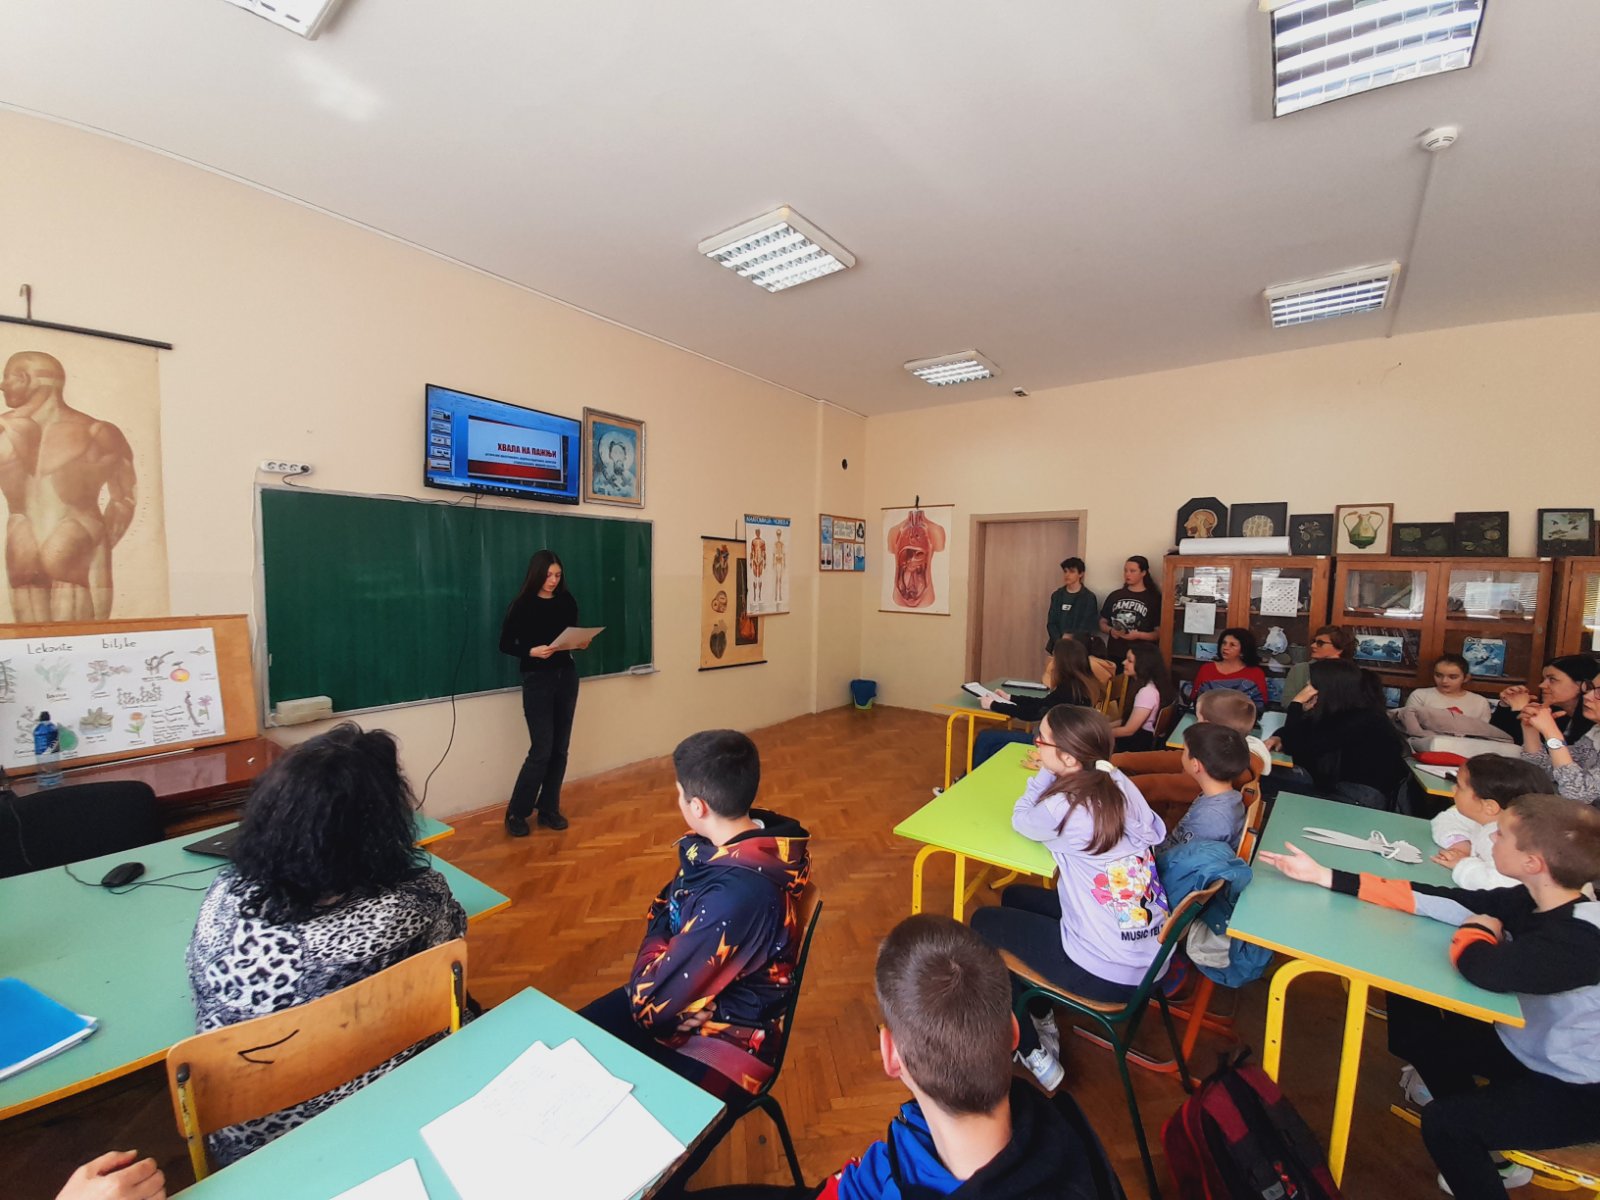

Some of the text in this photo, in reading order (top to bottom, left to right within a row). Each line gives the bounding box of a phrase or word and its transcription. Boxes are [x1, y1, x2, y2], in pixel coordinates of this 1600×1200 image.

[497, 442, 521, 454] ХВАЛА
[521, 446, 531, 455] НА
[1121, 924, 1163, 941] MUSIC TEL
